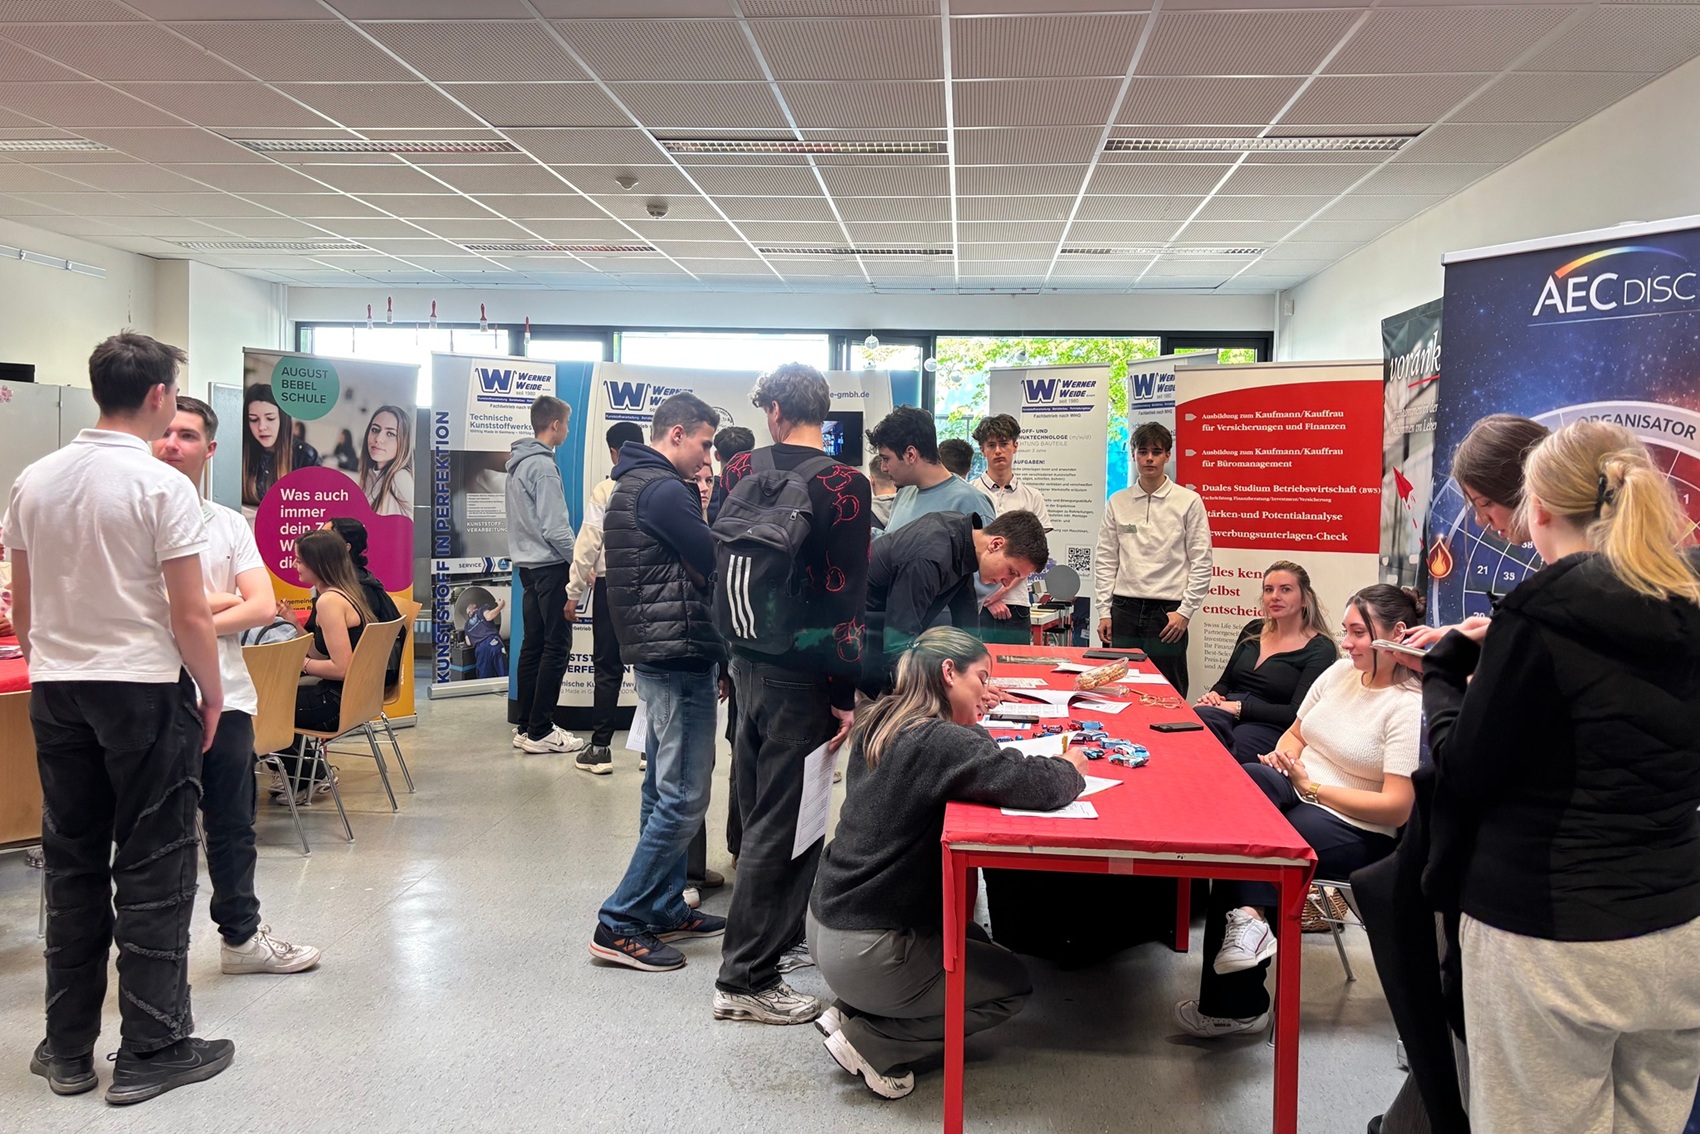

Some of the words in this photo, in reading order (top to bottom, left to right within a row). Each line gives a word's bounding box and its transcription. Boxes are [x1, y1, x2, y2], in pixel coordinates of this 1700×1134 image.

[1532, 272, 1619, 316] AEC
[1623, 272, 1697, 306] DISC
[281, 366, 328, 379] AUGUST
[518, 372, 552, 382] WERNER
[281, 379, 318, 391] BEBEL
[478, 368, 514, 392] W
[1062, 380, 1096, 388] WERNER
[1132, 373, 1157, 398] W
[516, 382, 542, 391] WEIDE
[1024, 379, 1058, 402] W
[281, 392, 327, 404] SCHULE
[606, 380, 648, 408] W
[830, 391, 870, 399] e-gmbh.de
[1060, 389, 1086, 397] WEIDE
[470, 414, 513, 422] Technische
[1255, 410, 1344, 418] Kaufmann/Kauffrau
[470, 422, 533, 430] Kunststoffwerks
[1217, 423, 1283, 432] Versicherungen
[1217, 460, 1292, 469] Büromanagement
[436, 412, 449, 531] PERFEKTION
[280, 488, 310, 501] Was
[314, 488, 349, 501] auch
[1273, 484, 1356, 493] Betriebswirtschaft
[1683, 493, 1690, 504] 1
[280, 505, 326, 518] immer
[1207, 510, 1259, 518] tärken-und
[1262, 511, 1343, 522] Potentialanalyse
[280, 522, 310, 535] dein
[1210, 529, 1348, 542] ewerbungsunterlagen-Check
[436, 536, 450, 555] IN
[1212, 566, 1234, 577] lles
[1238, 568, 1262, 578] ken
[1477, 565, 1488, 575] 21
[1208, 585, 1240, 596] elbst
[436, 561, 450, 684] KUNSTSTOFF
[570, 654, 594, 662] STST
